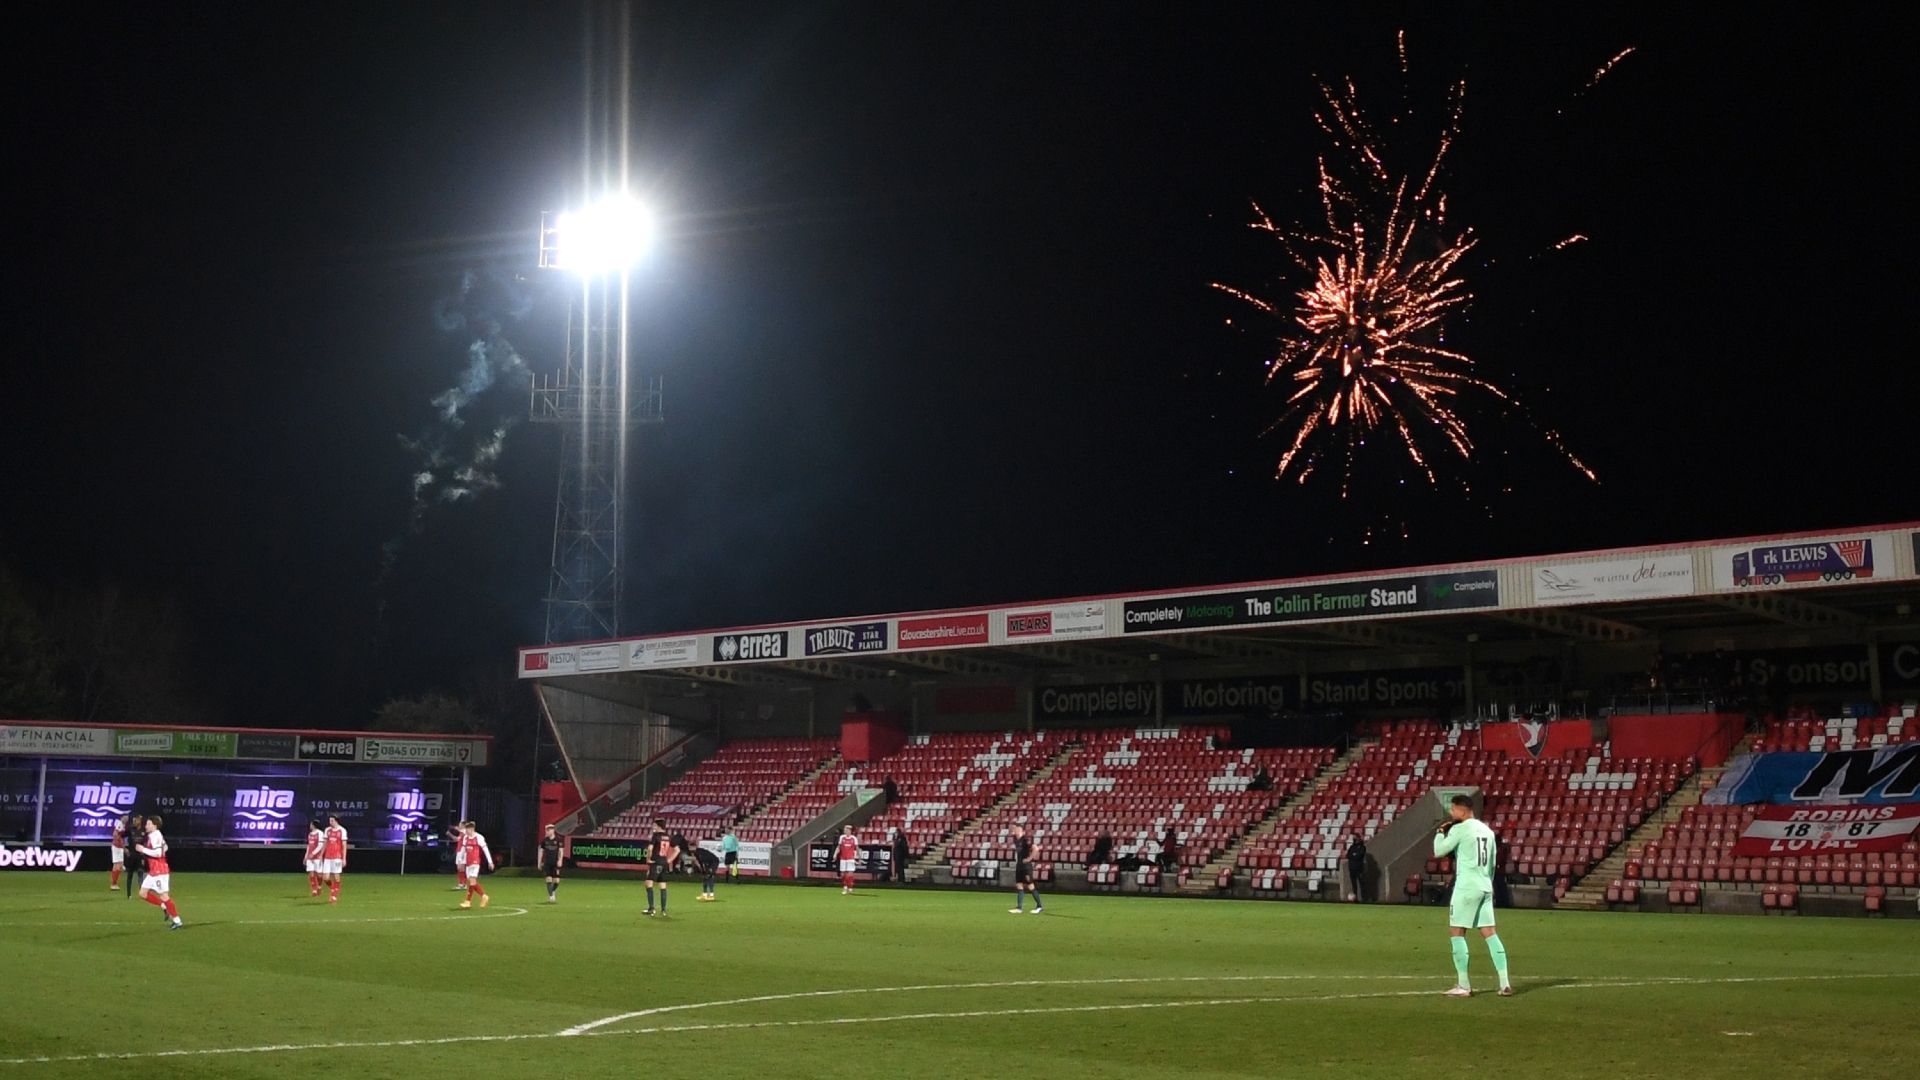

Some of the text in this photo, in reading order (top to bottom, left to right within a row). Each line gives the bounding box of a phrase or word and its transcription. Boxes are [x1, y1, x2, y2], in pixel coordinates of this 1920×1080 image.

[1764, 546, 1827, 564] rk LEWIS
[1607, 574, 1629, 582] LITTLE
[1632, 560, 1656, 583] Jet
[1658, 570, 1690, 578] COMPANY
[1453, 580, 1496, 592] Completely
[1126, 585, 1417, 624] Completely Motoring The Colin Farmer Stand
[900, 624, 985, 641] GloucestershireLive.co.uk
[1009, 617, 1050, 632] MEARS
[809, 626, 855, 654] TRIBUTE
[862, 631, 879, 640] STAR
[740, 633, 782, 659] errea
[858, 640, 883, 650] PLAYER
[550, 653, 576, 664] WESTON
[1749, 653, 1870, 686] Sonsor
[1042, 683, 1155, 716] Completely
[1182, 680, 1285, 712] Motoring
[1311, 678, 1368, 704] Stand
[21, 730, 95, 743] FINANCIAL
[318, 741, 354, 755] errea
[381, 747, 407, 756] 0845
[410, 748, 427, 756] 017
[72, 782, 137, 805] mira
[233, 785, 294, 809] mira
[386, 788, 443, 811] mira
[156, 797, 217, 808] 100 YEARS
[311, 800, 369, 810] 100 YEARS
[1788, 806, 1897, 822] ROBINS
[235, 821, 286, 830] SHOWERS
[1783, 822, 1881, 837] 18 87
[0, 844, 82, 872] betway
[1477, 837, 1488, 867] 13
[156, 879, 162, 890] 9
